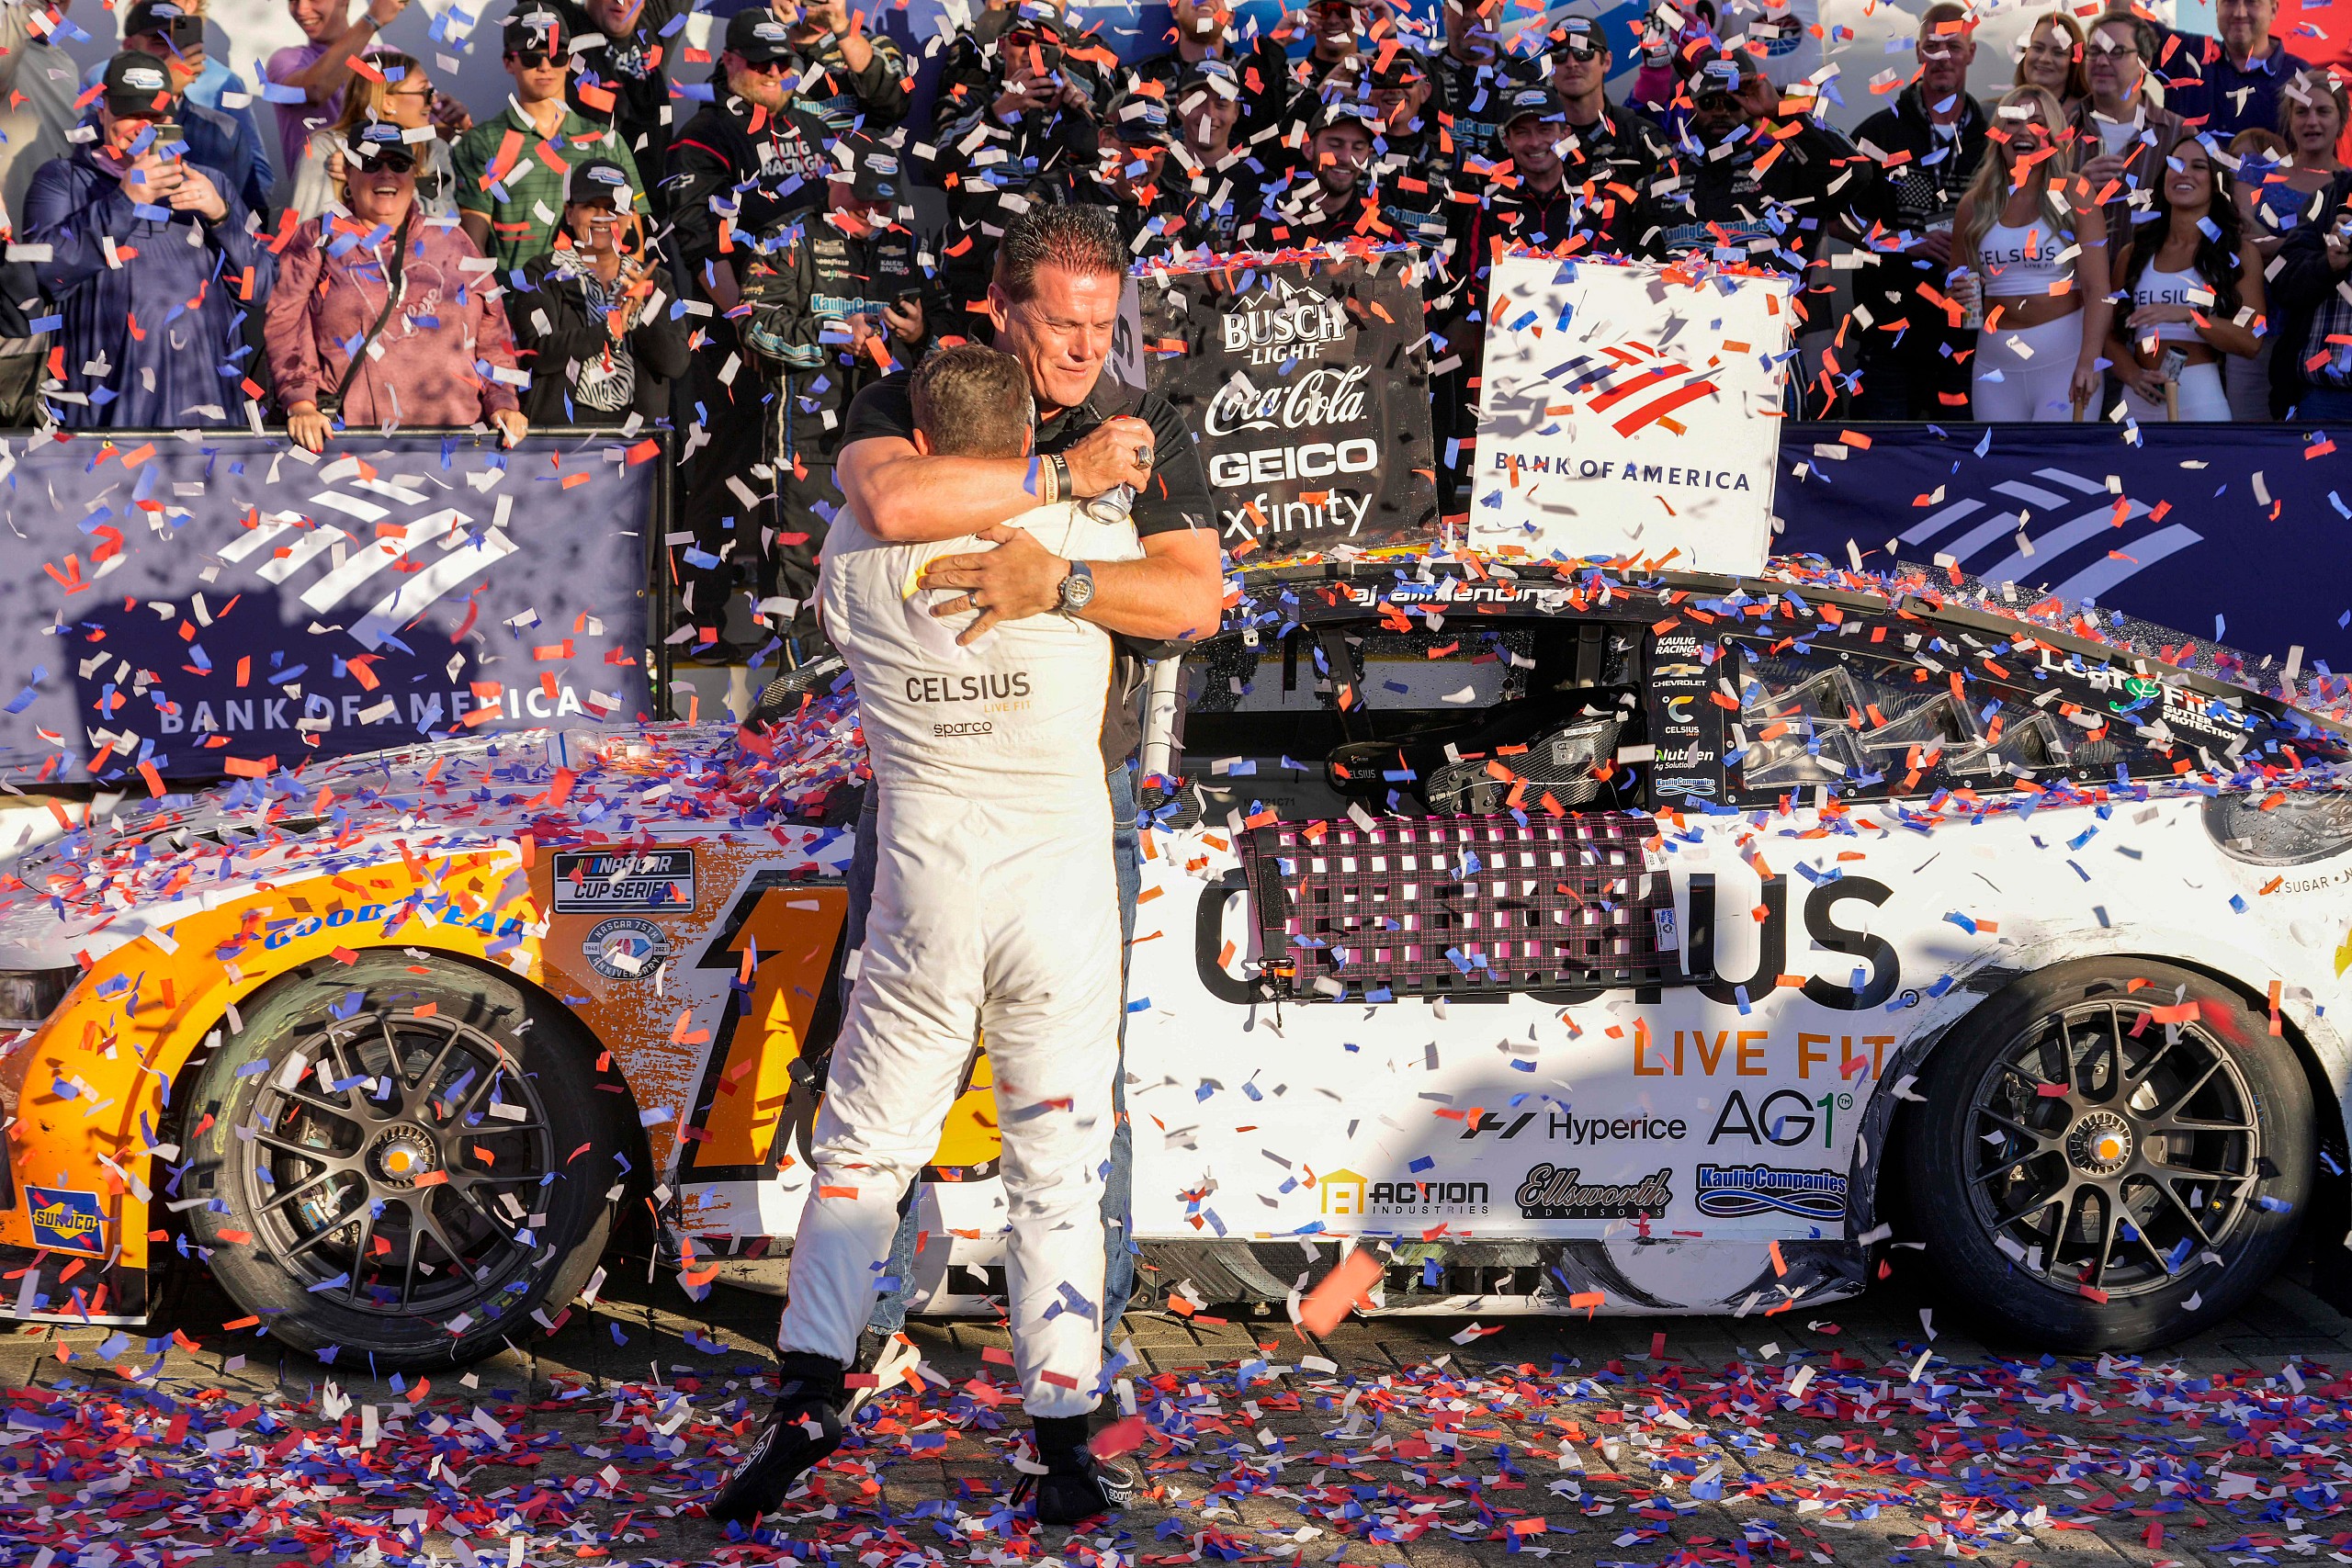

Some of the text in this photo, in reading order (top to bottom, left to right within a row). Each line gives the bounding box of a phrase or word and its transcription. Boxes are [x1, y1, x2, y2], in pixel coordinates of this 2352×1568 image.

[768, 141, 812, 159] AULIG
[761, 155, 816, 176] RACING
[2133, 289, 2190, 306] CELSIU
[1223, 303, 1346, 353] BUSCH
[1204, 365, 1372, 437] Coca-Cola
[1209, 438, 1378, 488] GEICO
[1495, 452, 1750, 491] BANK OF AMERICA
[1223, 488, 1373, 547] xfinity
[1350, 584, 1378, 607] aj
[1655, 645, 1696, 655] RACING
[1657, 637, 1696, 646] KAULIG
[906, 671, 1031, 702] CELSIUS
[1653, 680, 1707, 688] CHEVROLET
[160, 697, 290, 734] BANK
[304, 694, 361, 728] OF
[984, 701, 1031, 713] LIVE FIT
[2163, 705, 2213, 727] GUTTER
[933, 721, 992, 738] sparco
[1665, 726, 1700, 734] CELSIUS
[2163, 712, 2240, 741] PROTECTION
[1655, 748, 1714, 762] Nutren
[1348, 769, 1376, 780] ELSIUS
[1654, 761, 1698, 771] Ag Solutios
[1656, 777, 1715, 787] KauligCompanies
[574, 881, 674, 899] CUP SERIE
[2285, 876, 2329, 894] SUGAR
[594, 921, 660, 939] NASCAR 75TH
[1634, 1031, 1895, 1081] LIVE FIT
[1549, 1111, 1687, 1145] Hyperice
[1707, 1089, 1834, 1148] AG1
[1518, 1165, 1670, 1207] Ellsworth
[1701, 1167, 1846, 1194] KauligCompanies
[1369, 1182, 1488, 1204] ACTION
[1373, 1205, 1489, 1214] INDUSTRIES
[1525, 1208, 1663, 1217] ADVISORS
